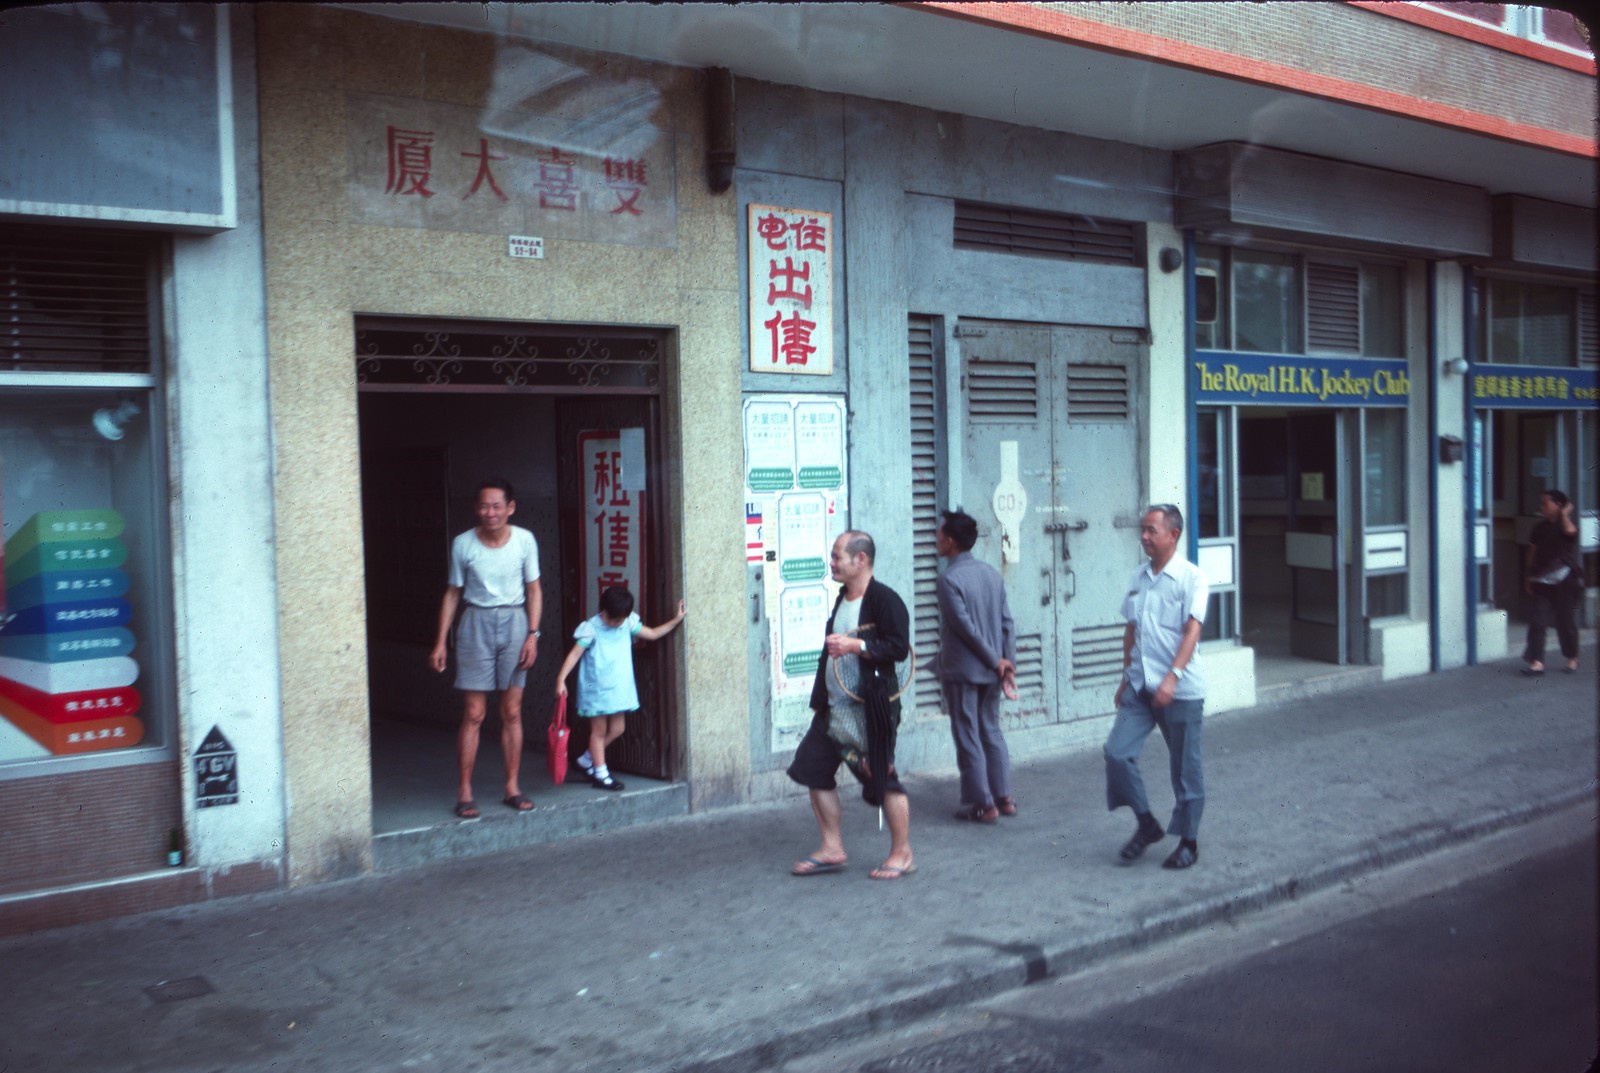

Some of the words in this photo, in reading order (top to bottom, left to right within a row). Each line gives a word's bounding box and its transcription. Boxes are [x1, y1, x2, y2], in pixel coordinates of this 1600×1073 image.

[385, 125, 648, 216] 雙喜大廈
[1223, 363, 1275, 397] Royal
[1277, 366, 1319, 395] H.K.
[1319, 368, 1371, 400] Jockey
[1373, 370, 1411, 396] Club
